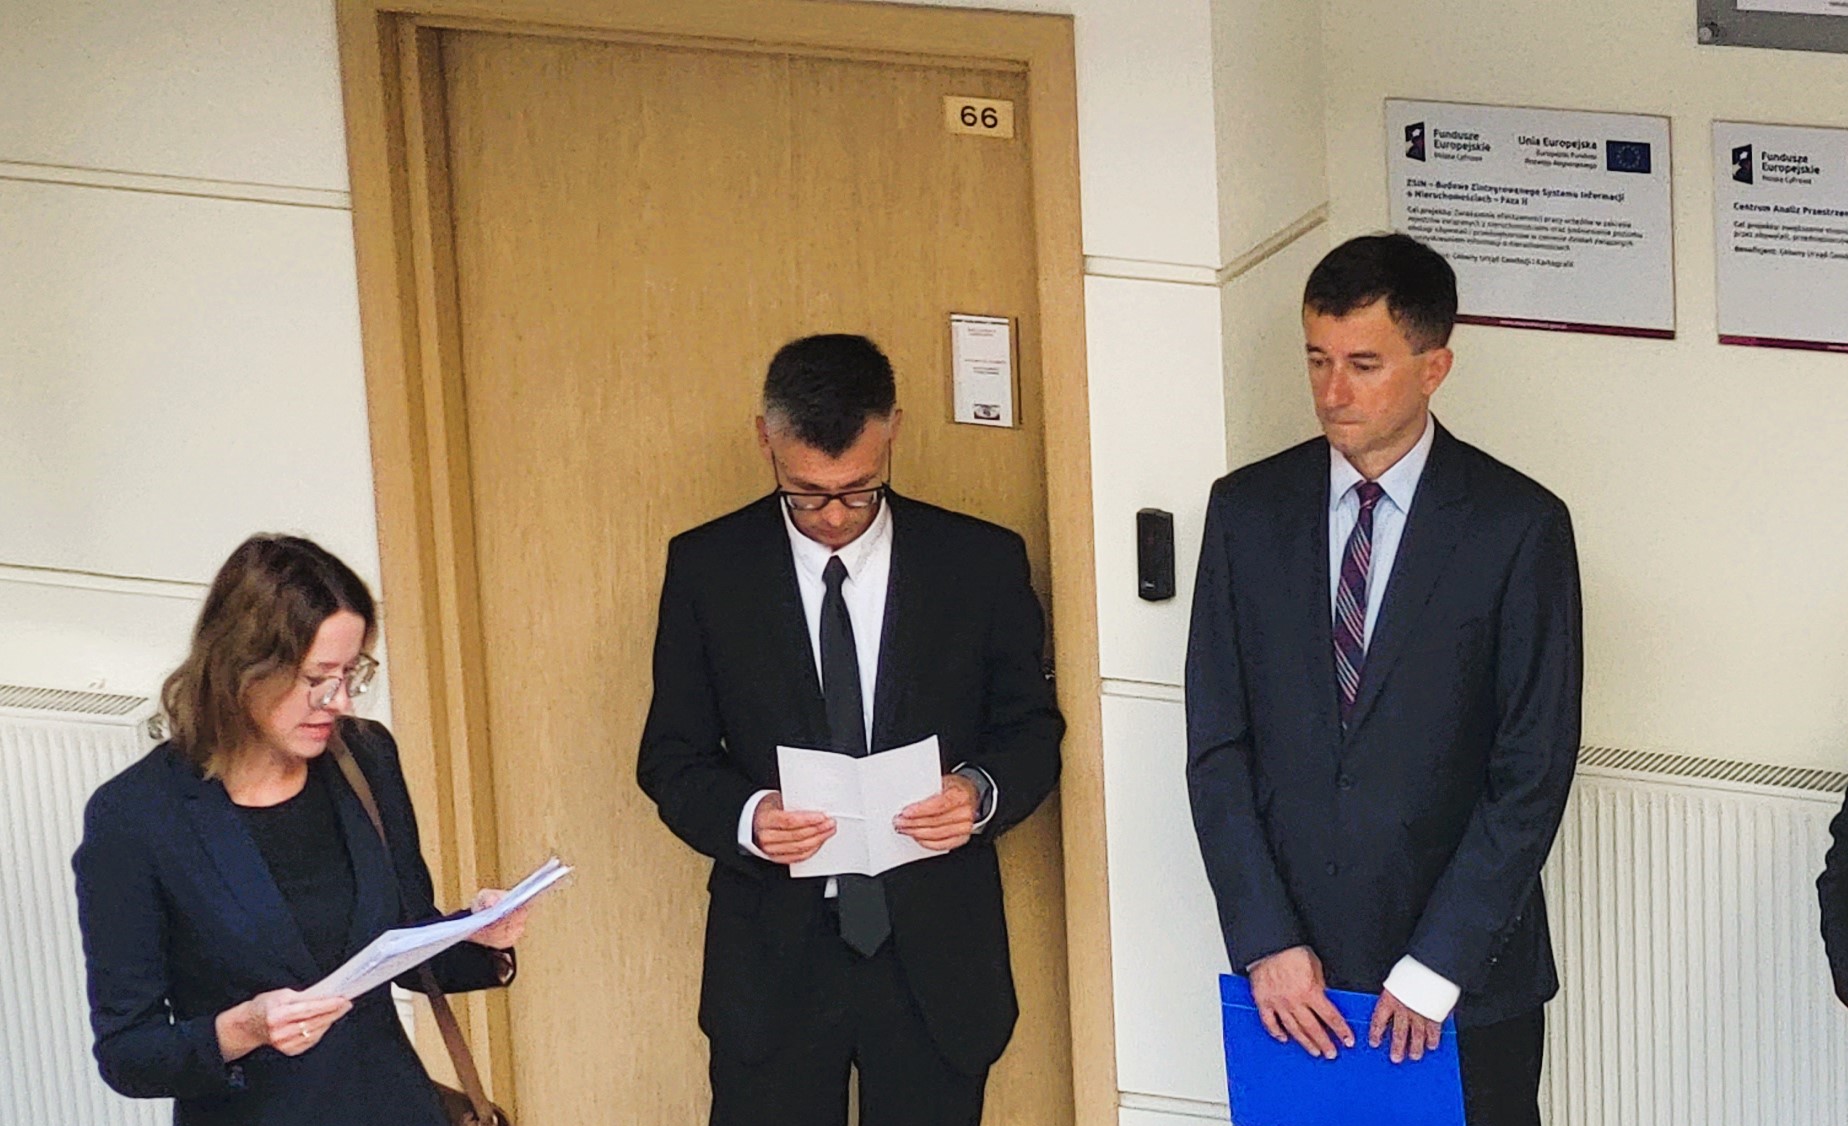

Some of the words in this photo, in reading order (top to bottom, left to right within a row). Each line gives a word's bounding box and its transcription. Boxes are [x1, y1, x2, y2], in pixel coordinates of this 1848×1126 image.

[960, 105, 998, 129] 66
[1433, 128, 1479, 141] Fundusze
[1433, 138, 1491, 153] Europejskie
[1517, 134, 1540, 146] Unia
[1542, 136, 1597, 151] Europejska
[1761, 150, 1808, 164] Fundusze
[1761, 161, 1820, 176] Europejskie
